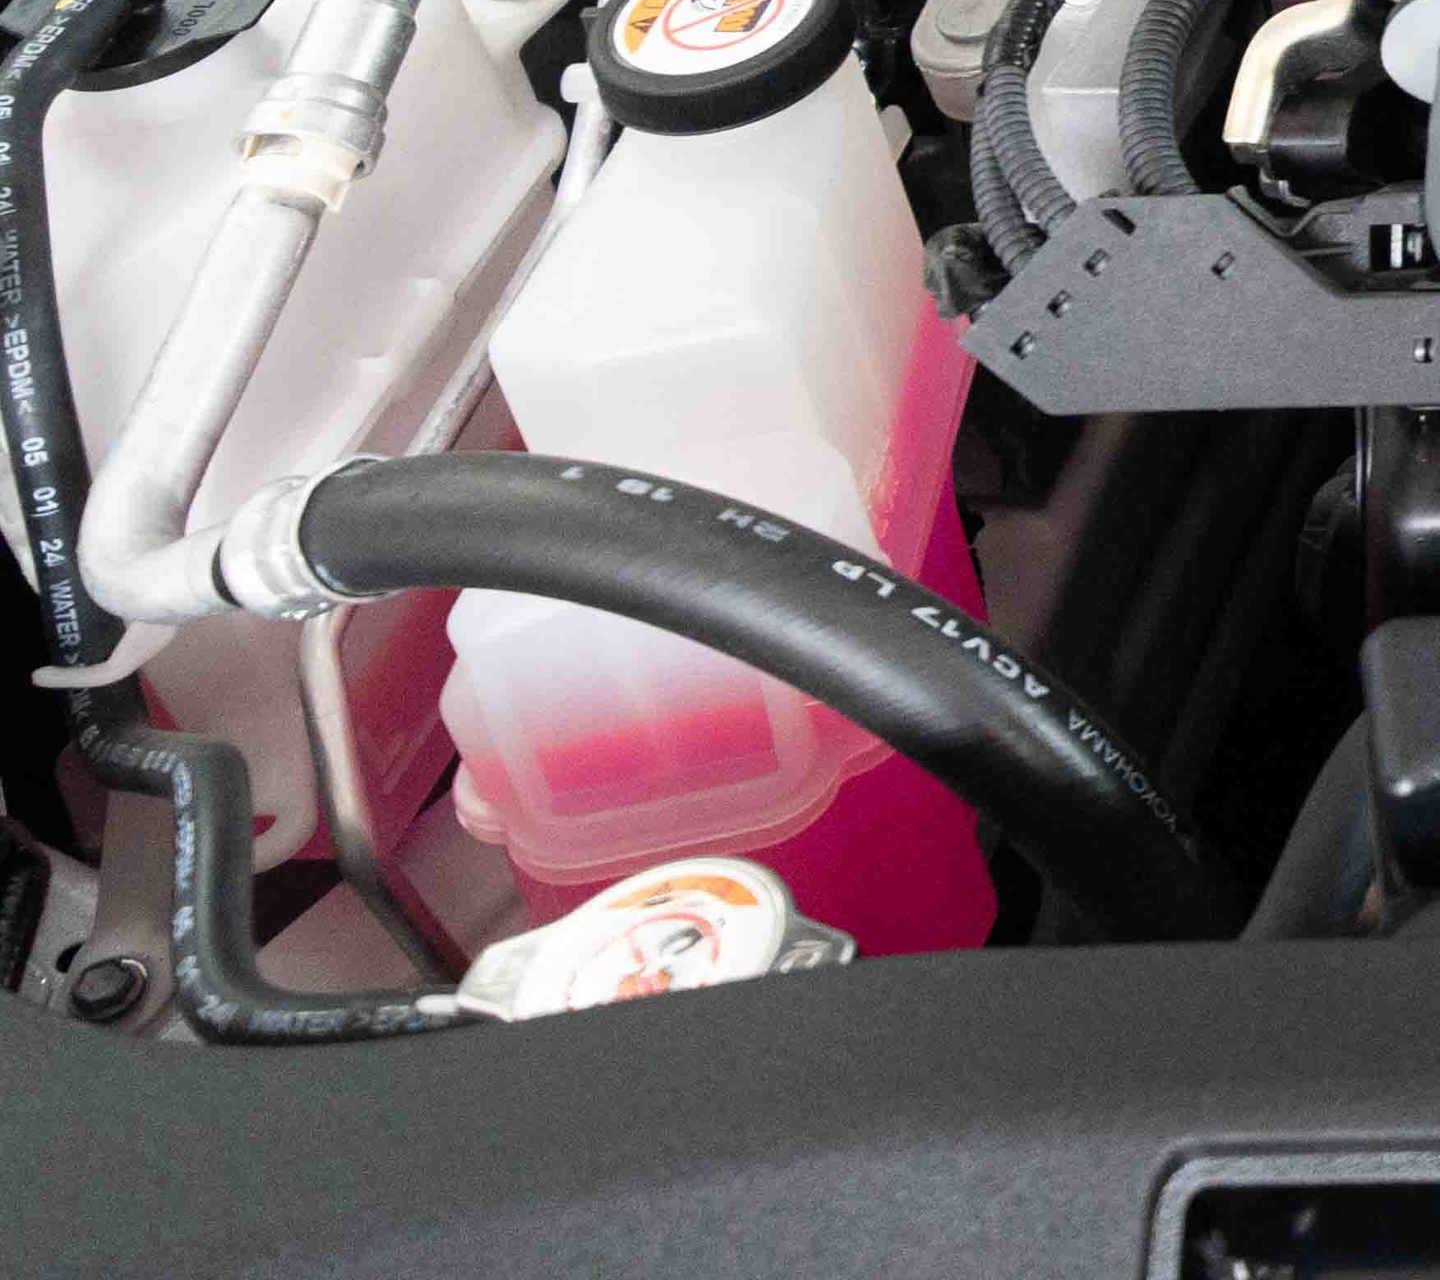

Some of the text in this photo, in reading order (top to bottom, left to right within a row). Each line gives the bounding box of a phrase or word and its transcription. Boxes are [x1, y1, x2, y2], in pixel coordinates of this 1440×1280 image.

[3, 312, 35, 416] >EPDM<
[21, 436, 48, 467] 05
[39, 538, 64, 568] 24
[831, 557, 897, 599] LP
[50, 579, 82, 649] WATER
[911, 604, 1050, 700] ACV17
[1067, 705, 1179, 835] YOKOHAMA
